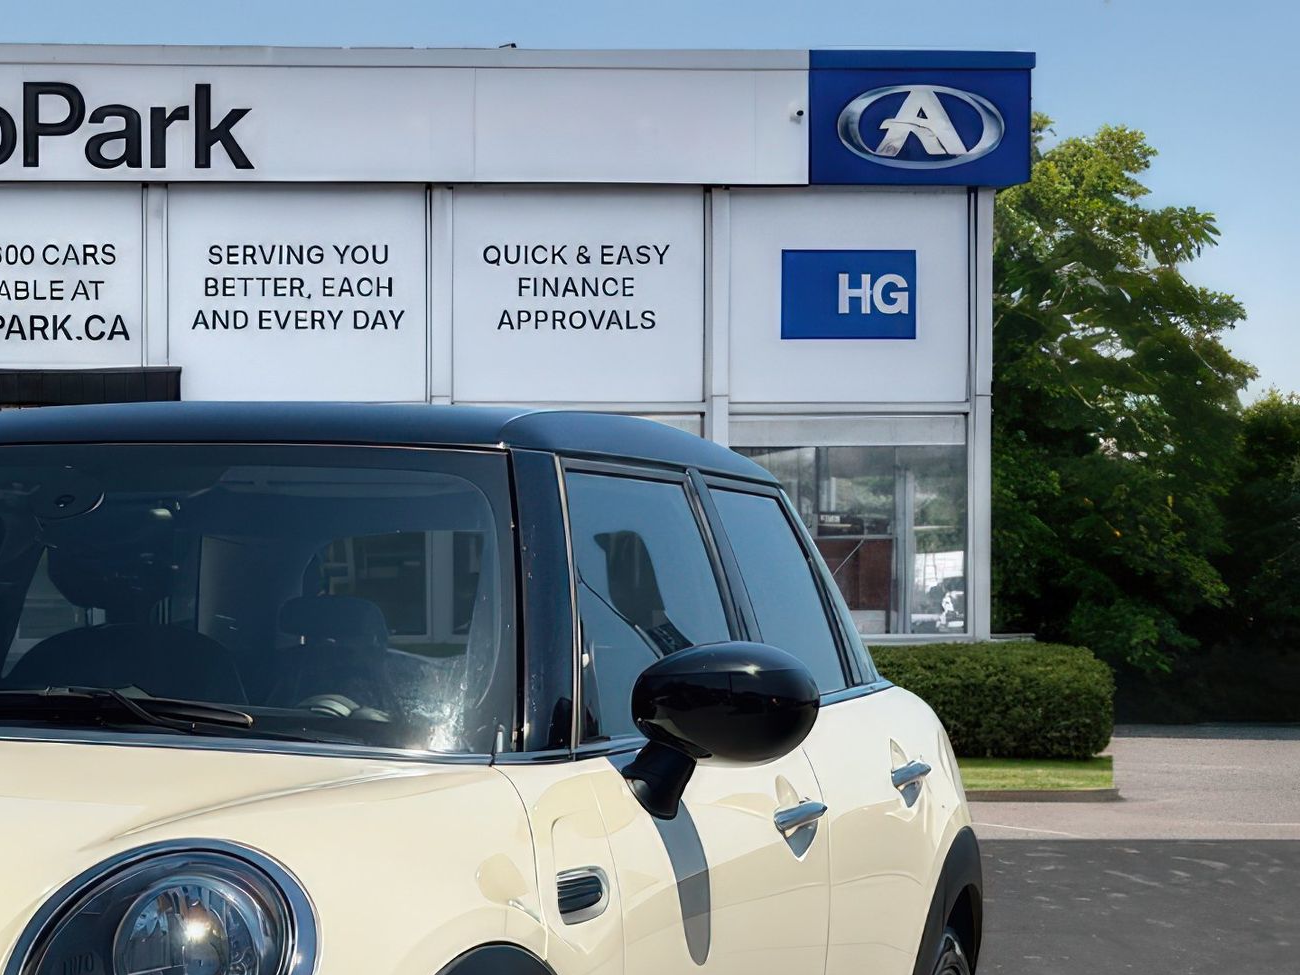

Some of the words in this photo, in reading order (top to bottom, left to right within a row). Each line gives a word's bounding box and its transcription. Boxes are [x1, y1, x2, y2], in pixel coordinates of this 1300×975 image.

[42, 243, 117, 266] CARS
[208, 244, 325, 266] SERVING
[332, 244, 389, 265] YOU
[482, 244, 566, 267] QUICK
[576, 244, 591, 265] &
[600, 244, 670, 266] EASY
[70, 279, 105, 302] AT
[204, 276, 312, 299] BETTER,
[322, 276, 393, 298] EACH
[518, 276, 635, 298] FINANCE
[838, 272, 910, 315] HG
[191, 309, 249, 330] AND
[258, 309, 344, 330] EVERY
[353, 309, 405, 331] DAY
[497, 309, 656, 331] APPROVALS
